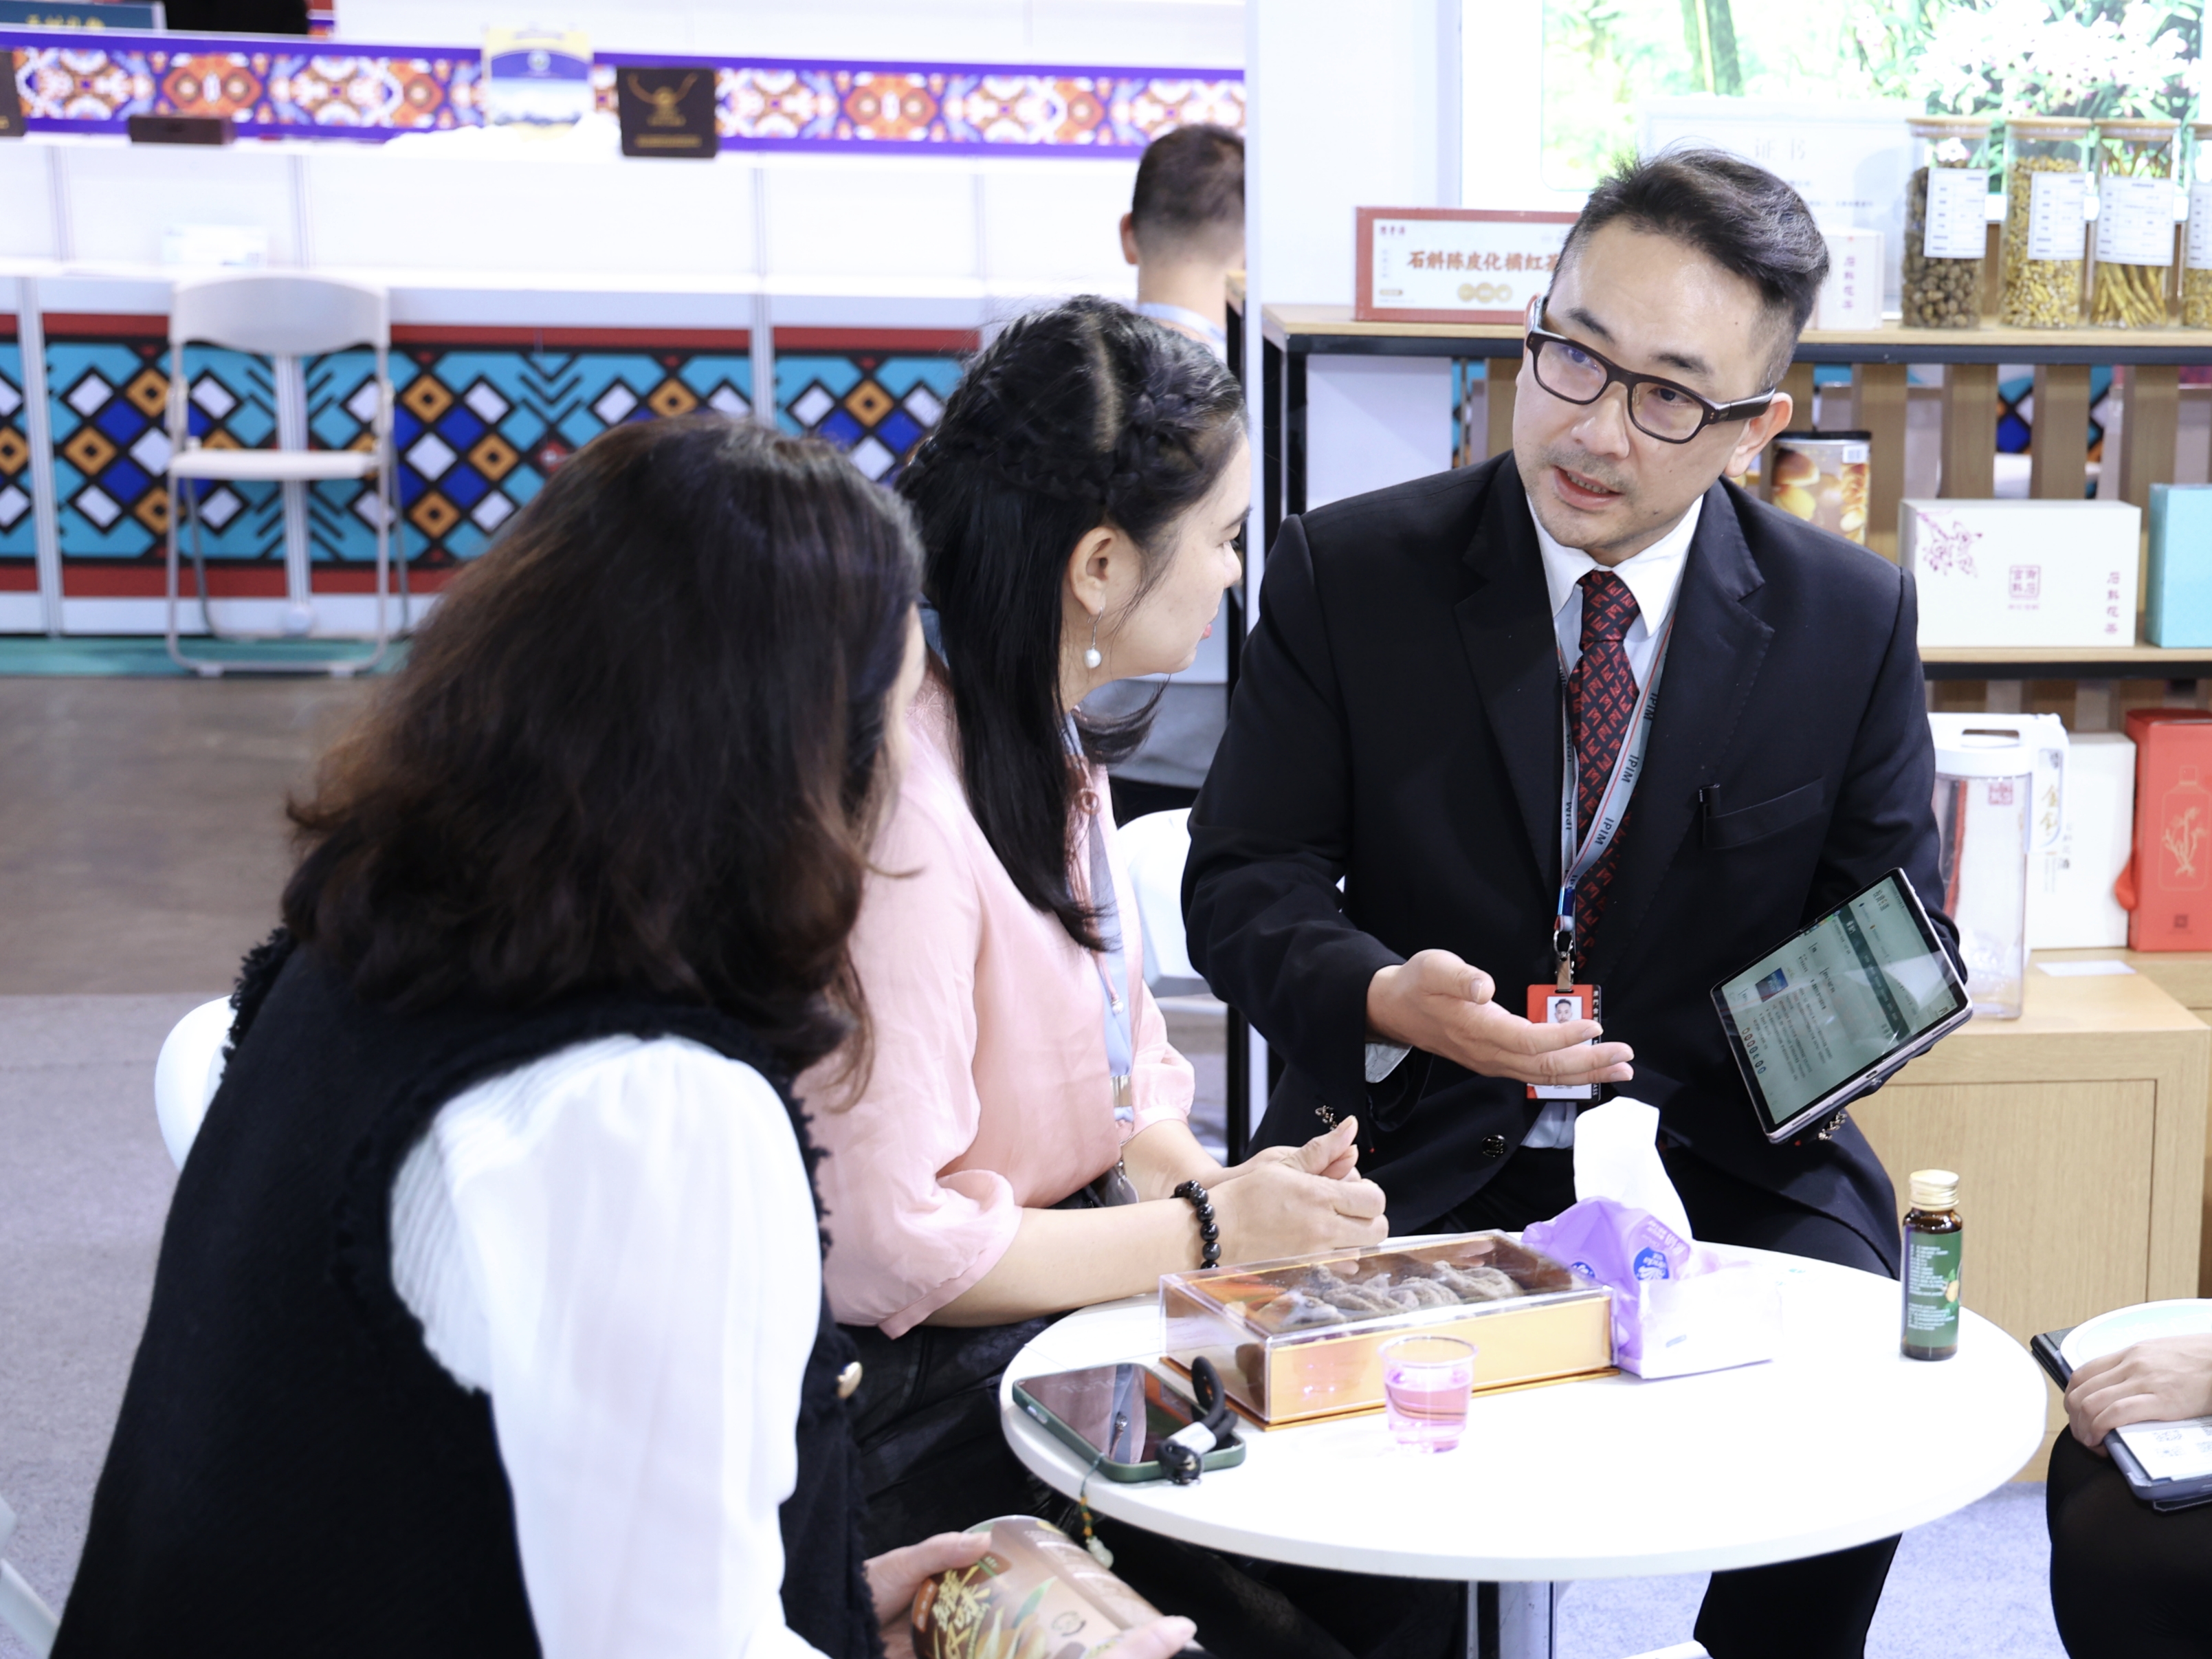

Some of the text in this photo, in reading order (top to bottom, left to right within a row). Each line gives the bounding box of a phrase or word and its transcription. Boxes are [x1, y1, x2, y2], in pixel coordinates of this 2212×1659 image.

[1644, 692, 1658, 720] IPIM
[1622, 754, 1640, 783] IPIM
[1595, 817, 1615, 846] IPIM
